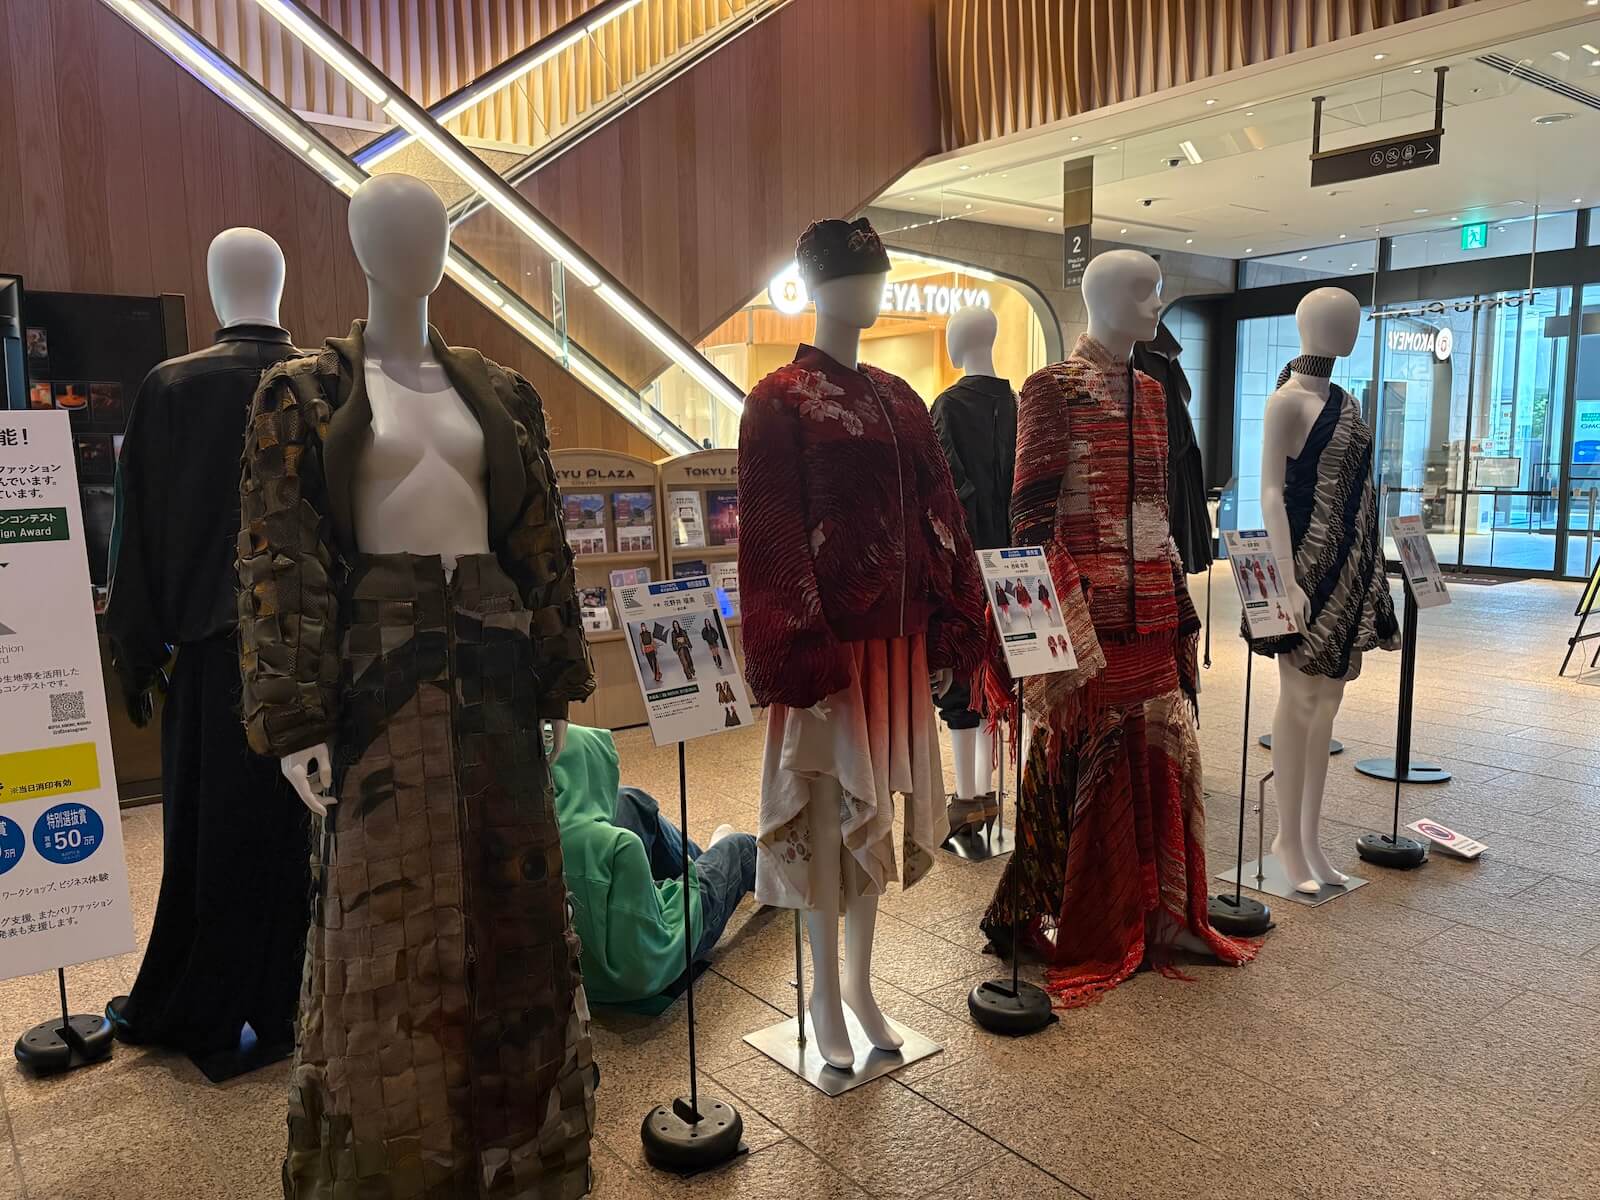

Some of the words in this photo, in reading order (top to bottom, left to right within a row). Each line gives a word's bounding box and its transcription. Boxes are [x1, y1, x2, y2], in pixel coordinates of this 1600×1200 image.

[1073, 236, 1081, 253] 2
[924, 285, 990, 315] TOKYO
[586, 469, 634, 479] PLAZA
[684, 466, 727, 476] TOKYU
[20, 526, 52, 537] Award
